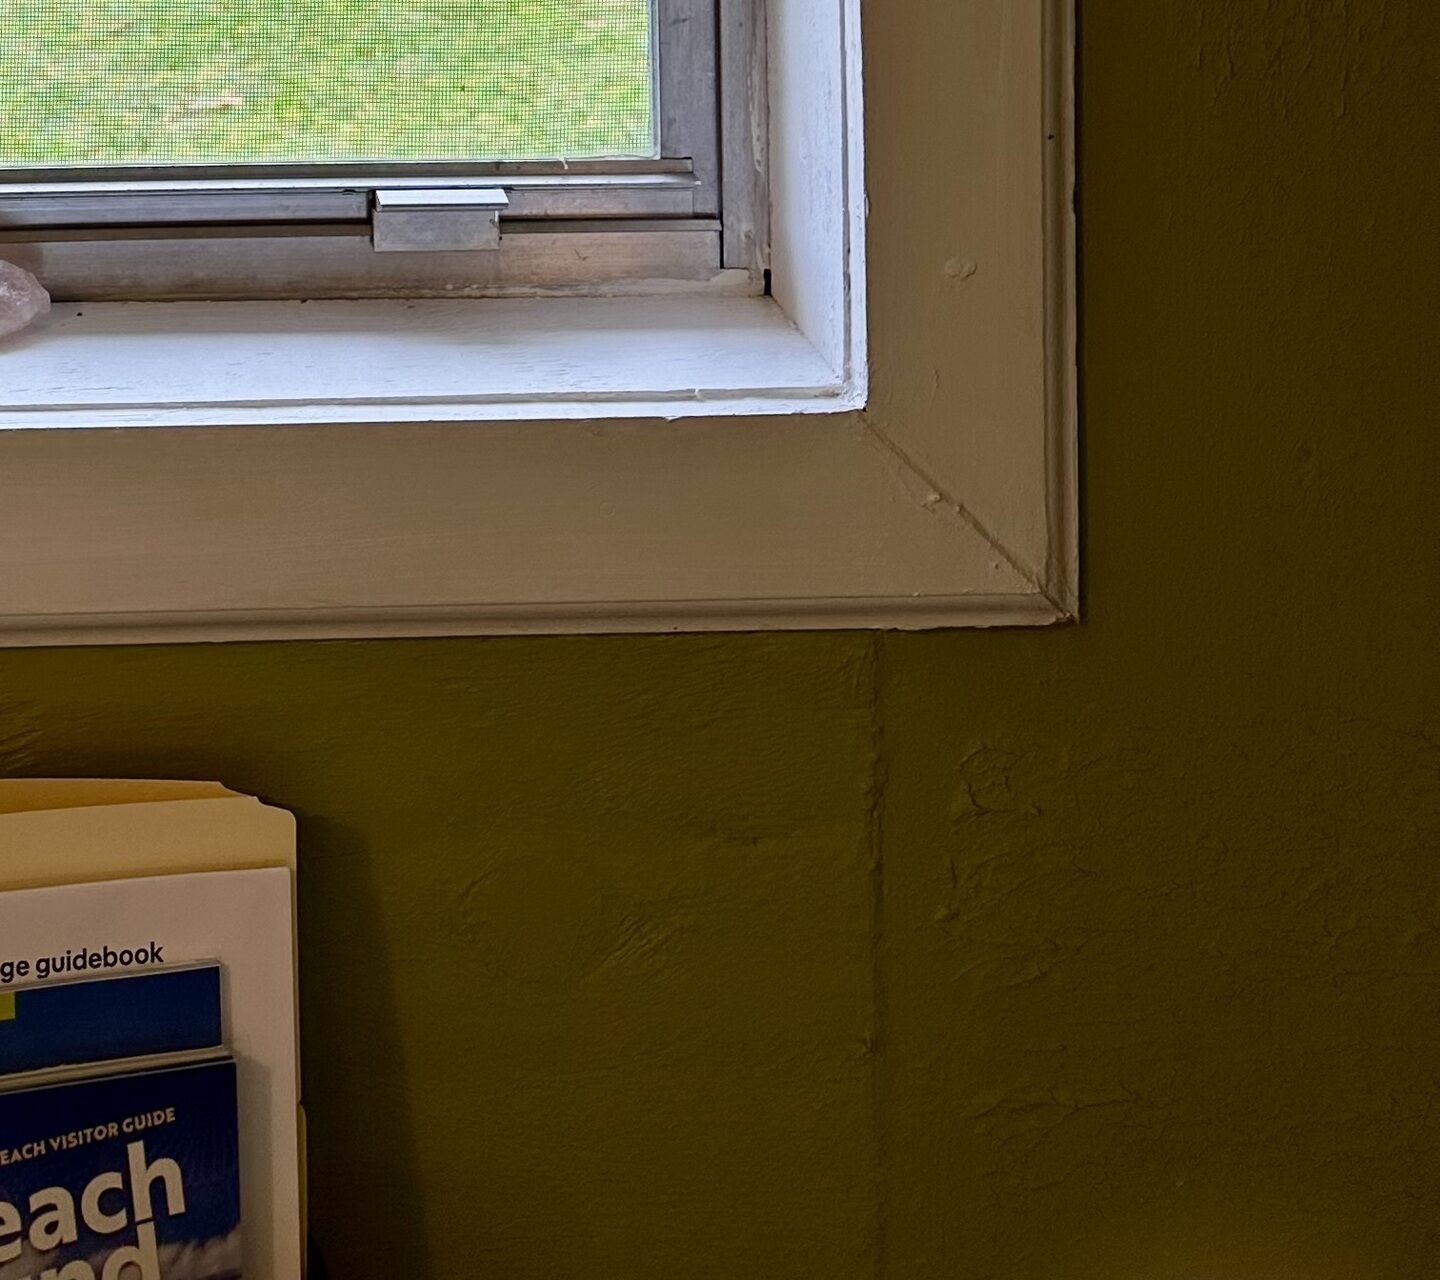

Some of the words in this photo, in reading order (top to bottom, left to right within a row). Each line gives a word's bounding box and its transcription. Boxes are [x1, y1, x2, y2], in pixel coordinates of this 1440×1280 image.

[35, 941, 164, 979] guidebook
[49, 1121, 119, 1152] VISITOR
[122, 1107, 177, 1133] GUIDE
